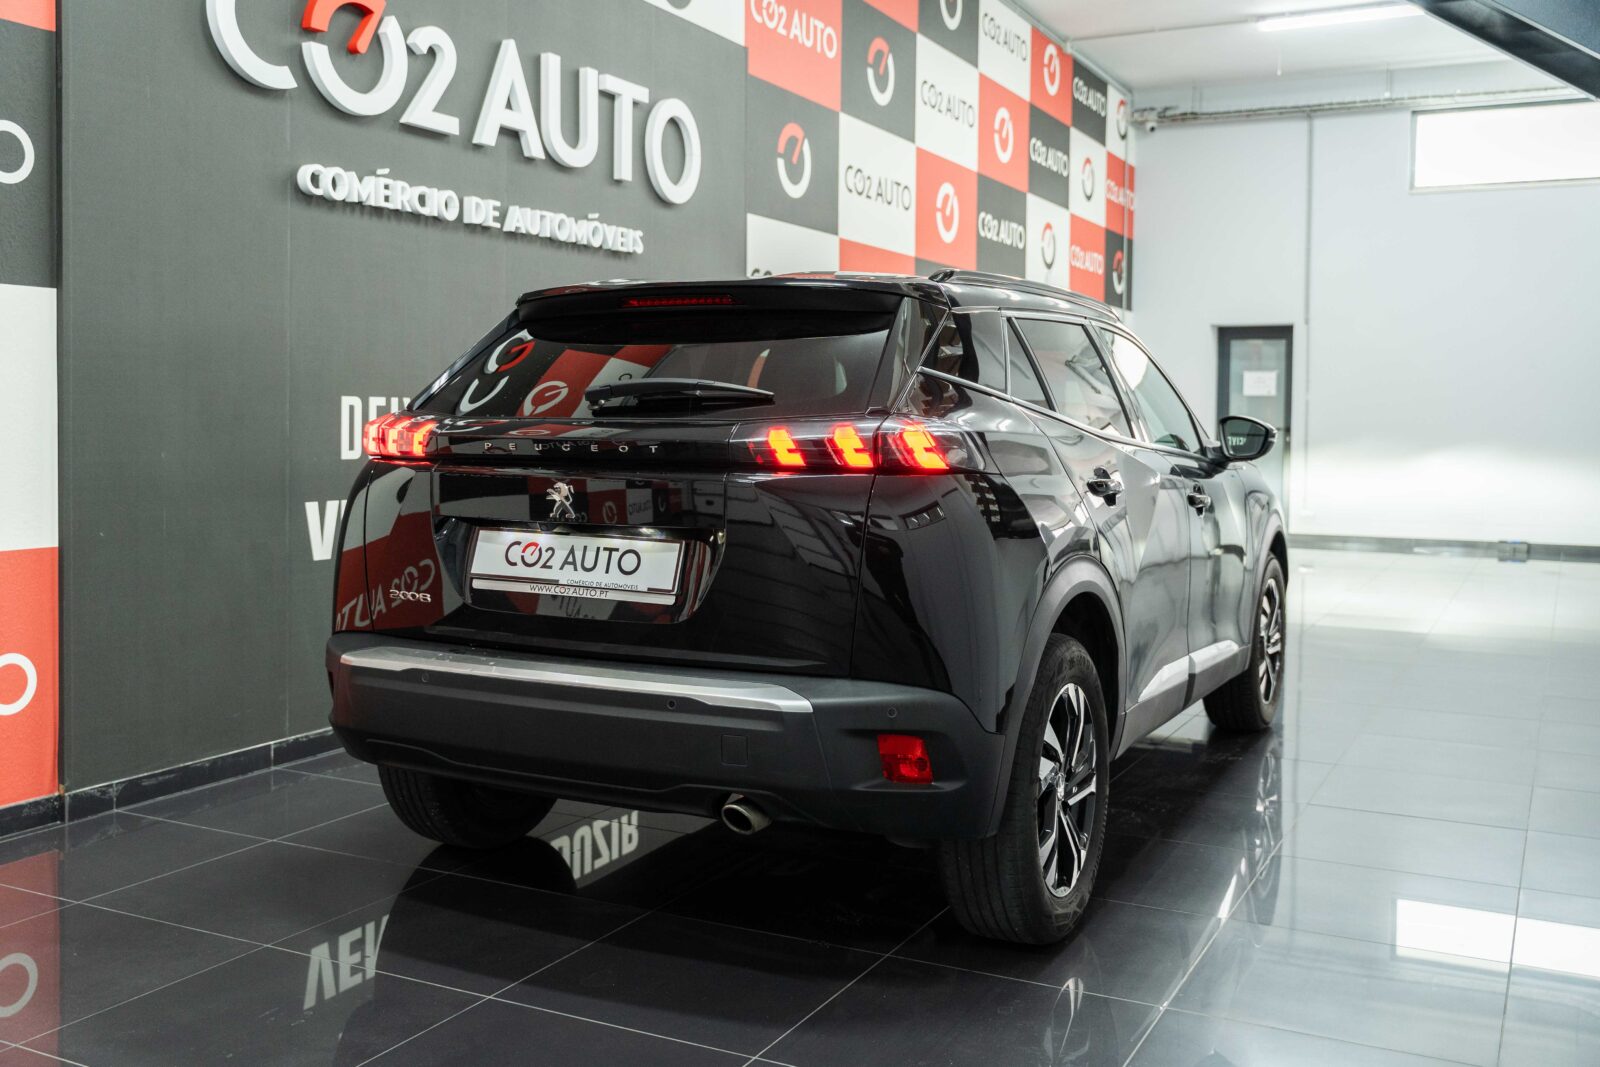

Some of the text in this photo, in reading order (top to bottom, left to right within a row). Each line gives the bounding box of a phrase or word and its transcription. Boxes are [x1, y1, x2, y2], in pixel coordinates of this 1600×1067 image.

[789, 9, 837, 59] AUTO
[1002, 27, 1028, 62] AUTO
[472, 38, 701, 205] AUTO
[920, 80, 976, 128] CO2 AUTO
[1047, 146, 1070, 178] AUTO
[844, 164, 912, 212] CO2 AUTO
[297, 164, 644, 255] COMÉRCIO DE AUTOMÓVEIS
[978, 211, 1026, 250] CO2 AUTO
[484, 442, 659, 454] PEUGEOT
[504, 540, 642, 576] CO2 AUTO
[389, 589, 432, 603] 2008
